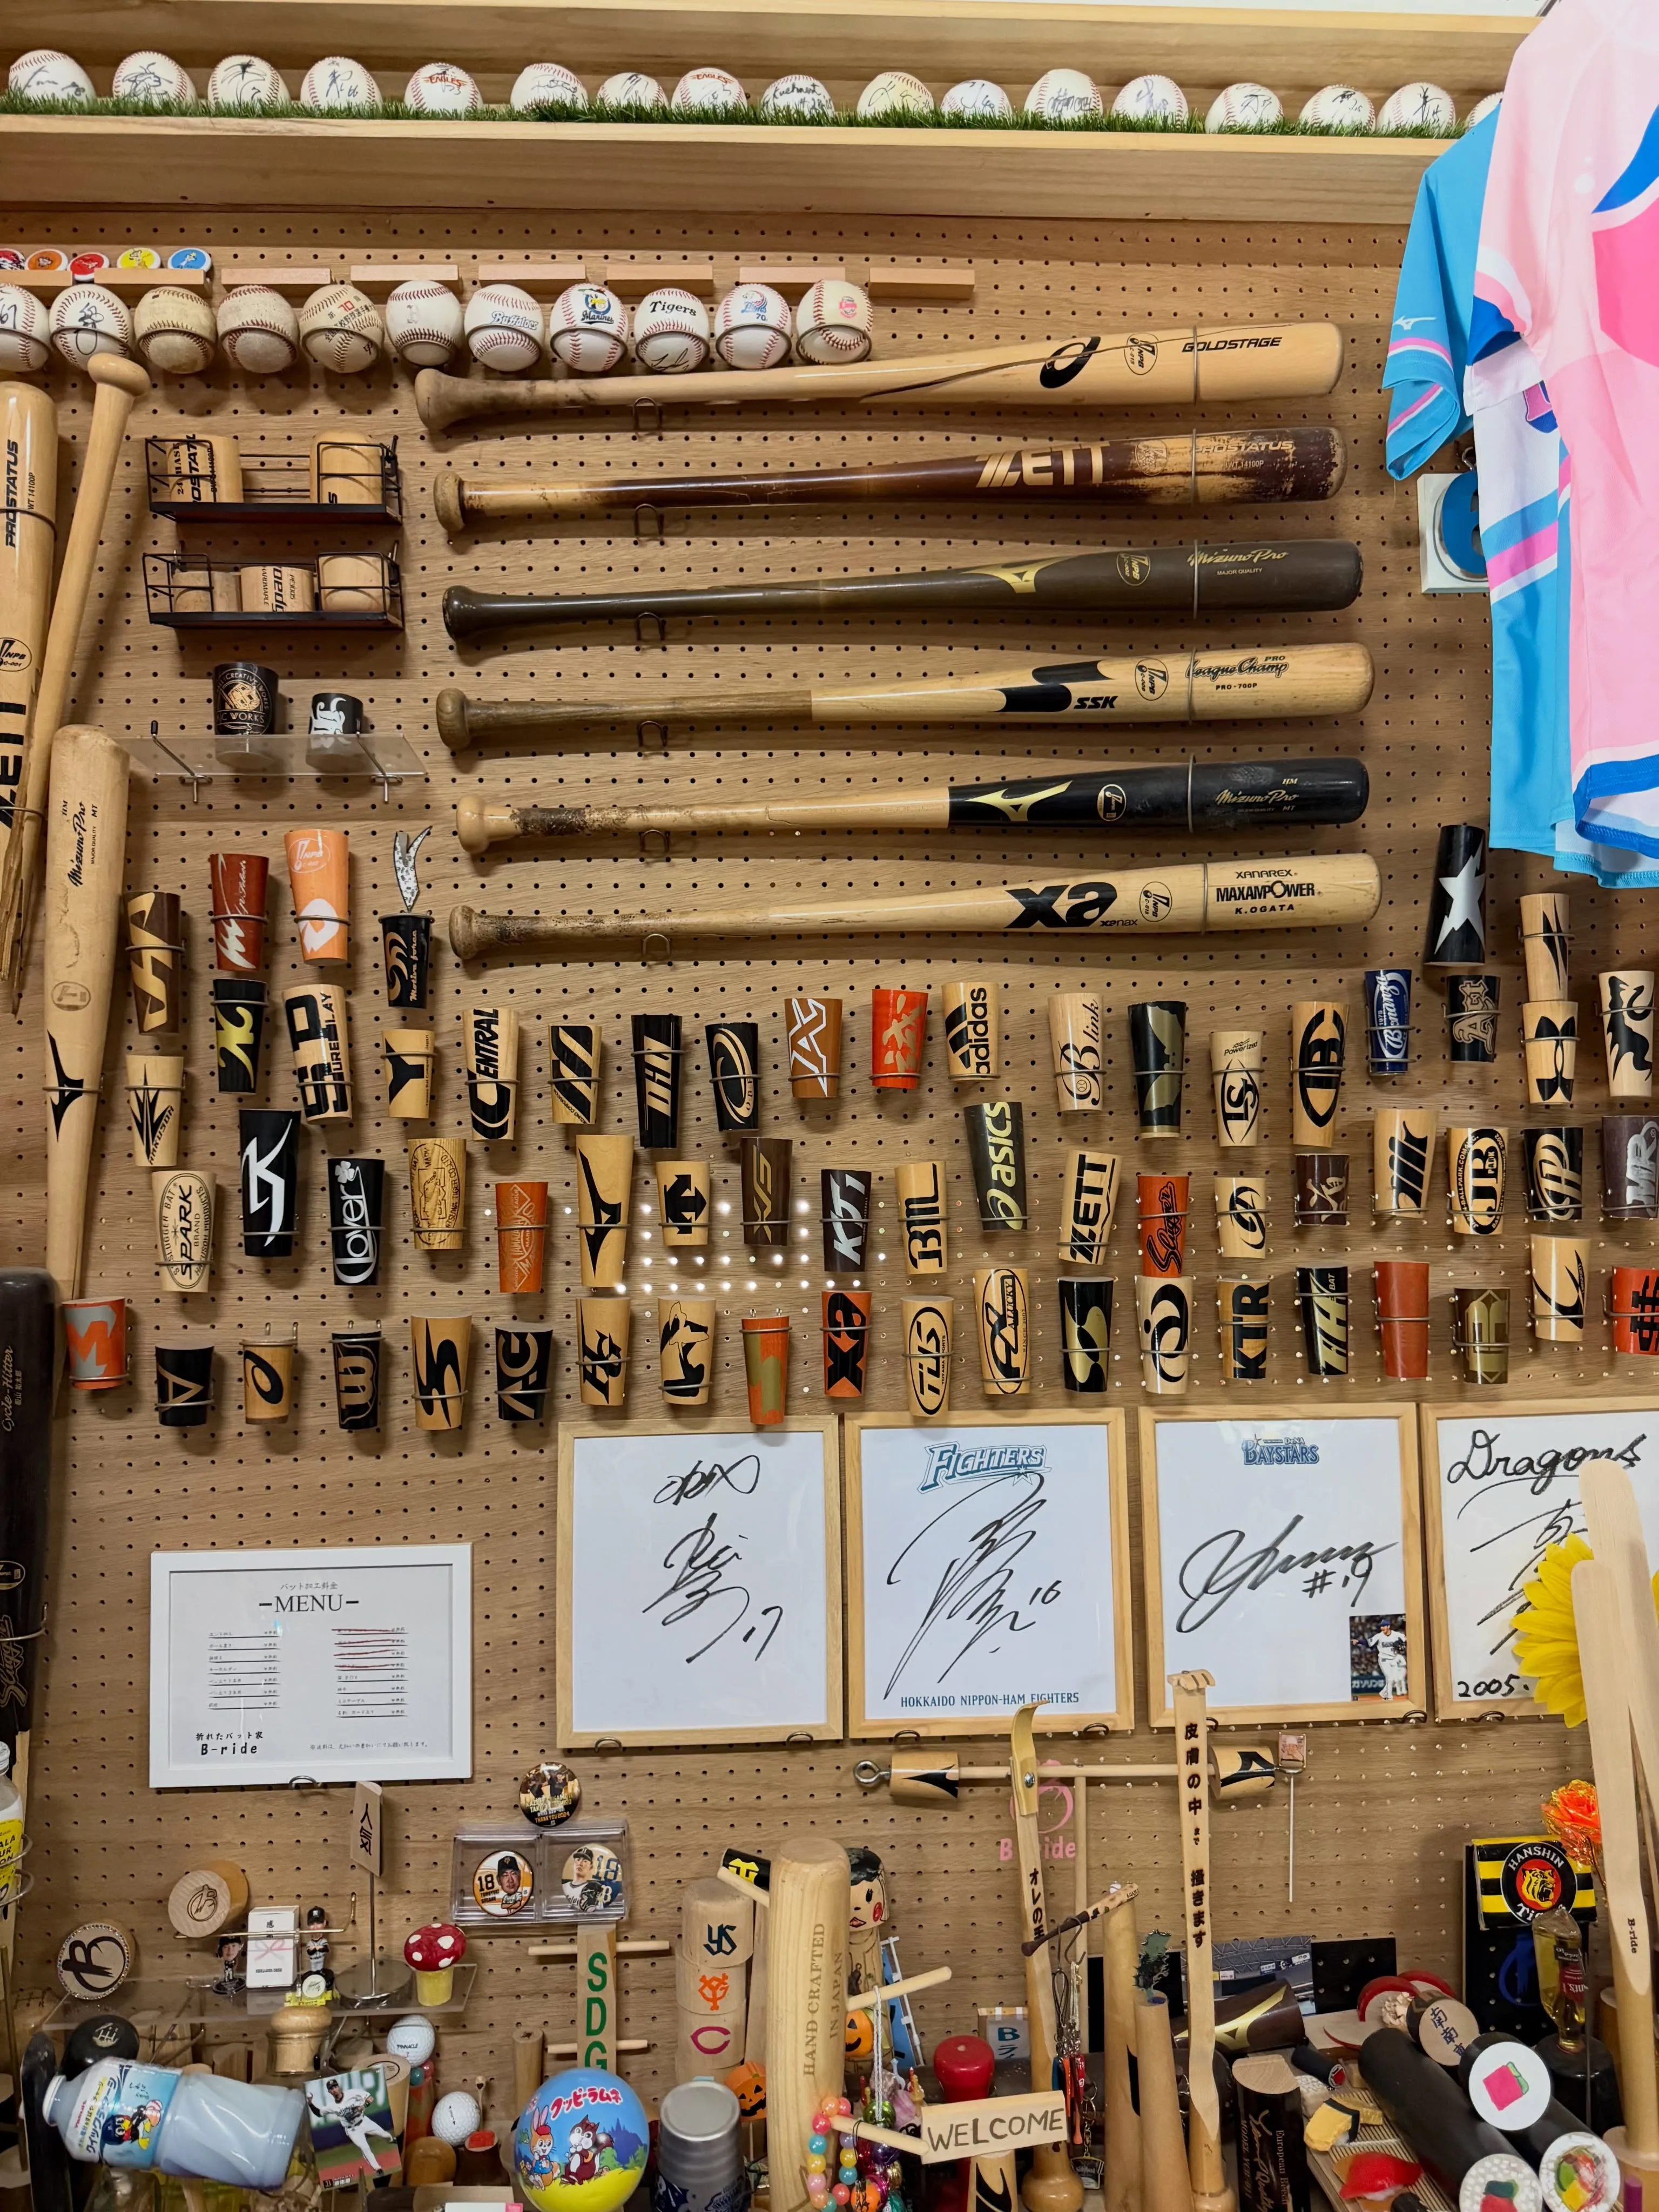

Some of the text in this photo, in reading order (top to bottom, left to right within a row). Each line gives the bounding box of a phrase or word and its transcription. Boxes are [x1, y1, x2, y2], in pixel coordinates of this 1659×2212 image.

[427, 74, 461, 87] EAGLES
[696, 72, 730, 83] EAGLES
[581, 311, 615, 323] Marines
[650, 300, 697, 316] Tigers
[491, 311, 539, 331] Buffaloes
[1182, 336, 1283, 353] GOLDSTAGE
[977, 442, 1110, 490] ZETT
[6, 439, 19, 548] PROSTATUS
[1188, 549, 1289, 567] Mizuno Pro
[1131, 560, 1141, 581] NPB
[3, 650, 26, 660] NPB
[1237, 656, 1290, 678] Champ
[1073, 696, 1118, 709] SSK
[230, 712, 265, 724] WORKS
[1215, 789, 1300, 806] Mizuno Pro
[91, 803, 98, 818] MT
[67, 800, 87, 887] Mizuno Pro
[1236, 869, 1292, 879] XANAREX
[1216, 880, 1316, 902] MAXAMPOWER
[1151, 896, 1160, 918] NPB
[1235, 903, 1295, 914] K.OGATA
[1100, 918, 1138, 928] xanax
[1375, 972, 1404, 1050] Bonanza
[970, 987, 991, 1079] adidas
[1224, 1040, 1258, 1056] Powerized
[467, 1008, 511, 1139] CENTRAL
[984, 1102, 1017, 1188] asics
[164, 1189, 176, 1210] BAT
[1070, 1154, 1108, 1264] ZETT
[180, 1184, 192, 1280] SPARK
[1147, 1179, 1183, 1276] Slugger
[1327, 1272, 1337, 1291] BAT
[1006, 1280, 1015, 1329] A.LUCKY
[1232, 1283, 1270, 1379] KTR
[1284, 1437, 1305, 1445] DeNA
[1242, 1440, 1320, 1465] BAYSTARS
[920, 1442, 1047, 1493] FIGHTERS
[1029, 1580, 1062, 1606] 16
[900, 1691, 1080, 1708] HOKKAIDO NIPPON-HAM FIGHTERS
[195, 1731, 263, 1741] 折れたバット家
[201, 1742, 258, 1756] B-ride
[359, 1803, 373, 1857] 人気
[592, 1855, 619, 1880] 18
[1507, 1846, 1565, 1871] HANSHIN
[477, 1873, 495, 1892] 18
[1627, 1917, 1637, 1954] B-ride
[803, 1923, 825, 2076] HAND CRAFTED
[829, 1952, 844, 2039] IN JAPAN
[550, 2086, 624, 2121] クッピーラムネ
[927, 2107, 1065, 2153] WELCOME
[1275, 2129, 1286, 2174] European
